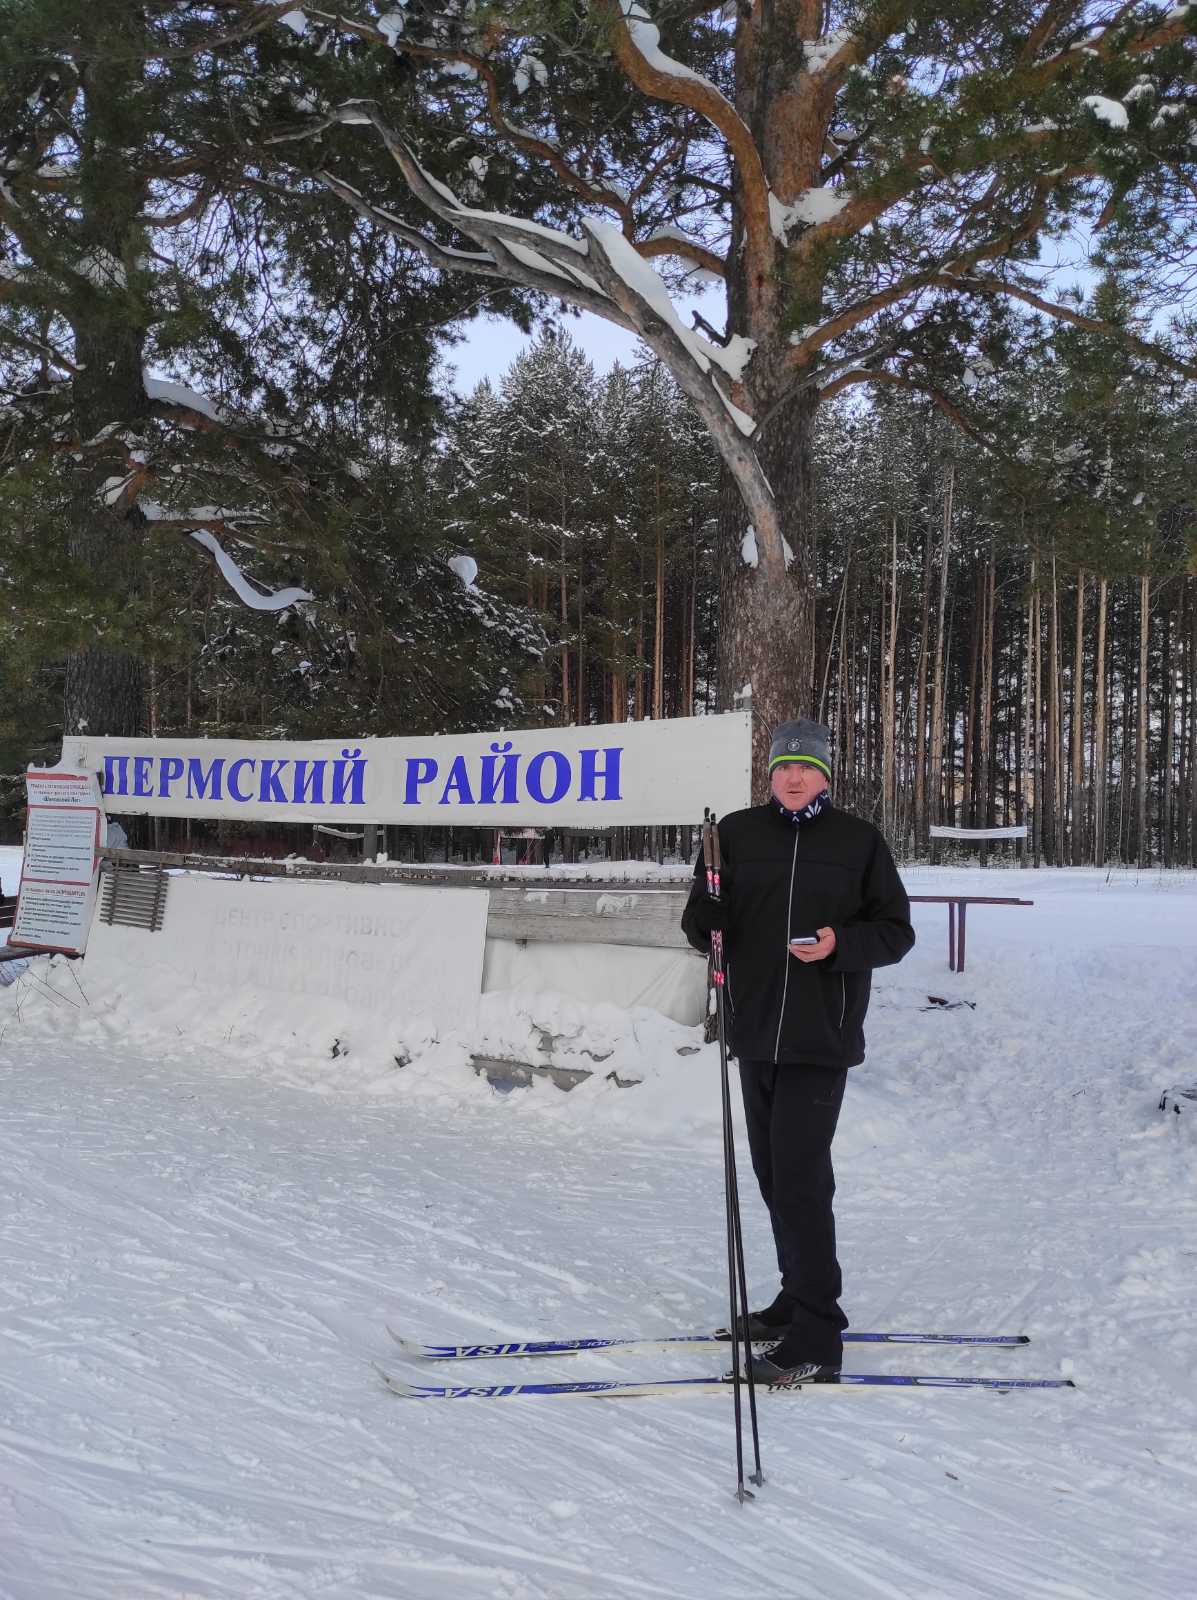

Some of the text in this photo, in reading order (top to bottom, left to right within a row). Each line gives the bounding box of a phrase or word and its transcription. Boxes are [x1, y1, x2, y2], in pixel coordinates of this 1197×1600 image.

[104, 742, 623, 805] ПЕРМСКИЙ РАЙОН
[455, 1343, 527, 1357] TISA
[445, 1385, 522, 1398] TISA
